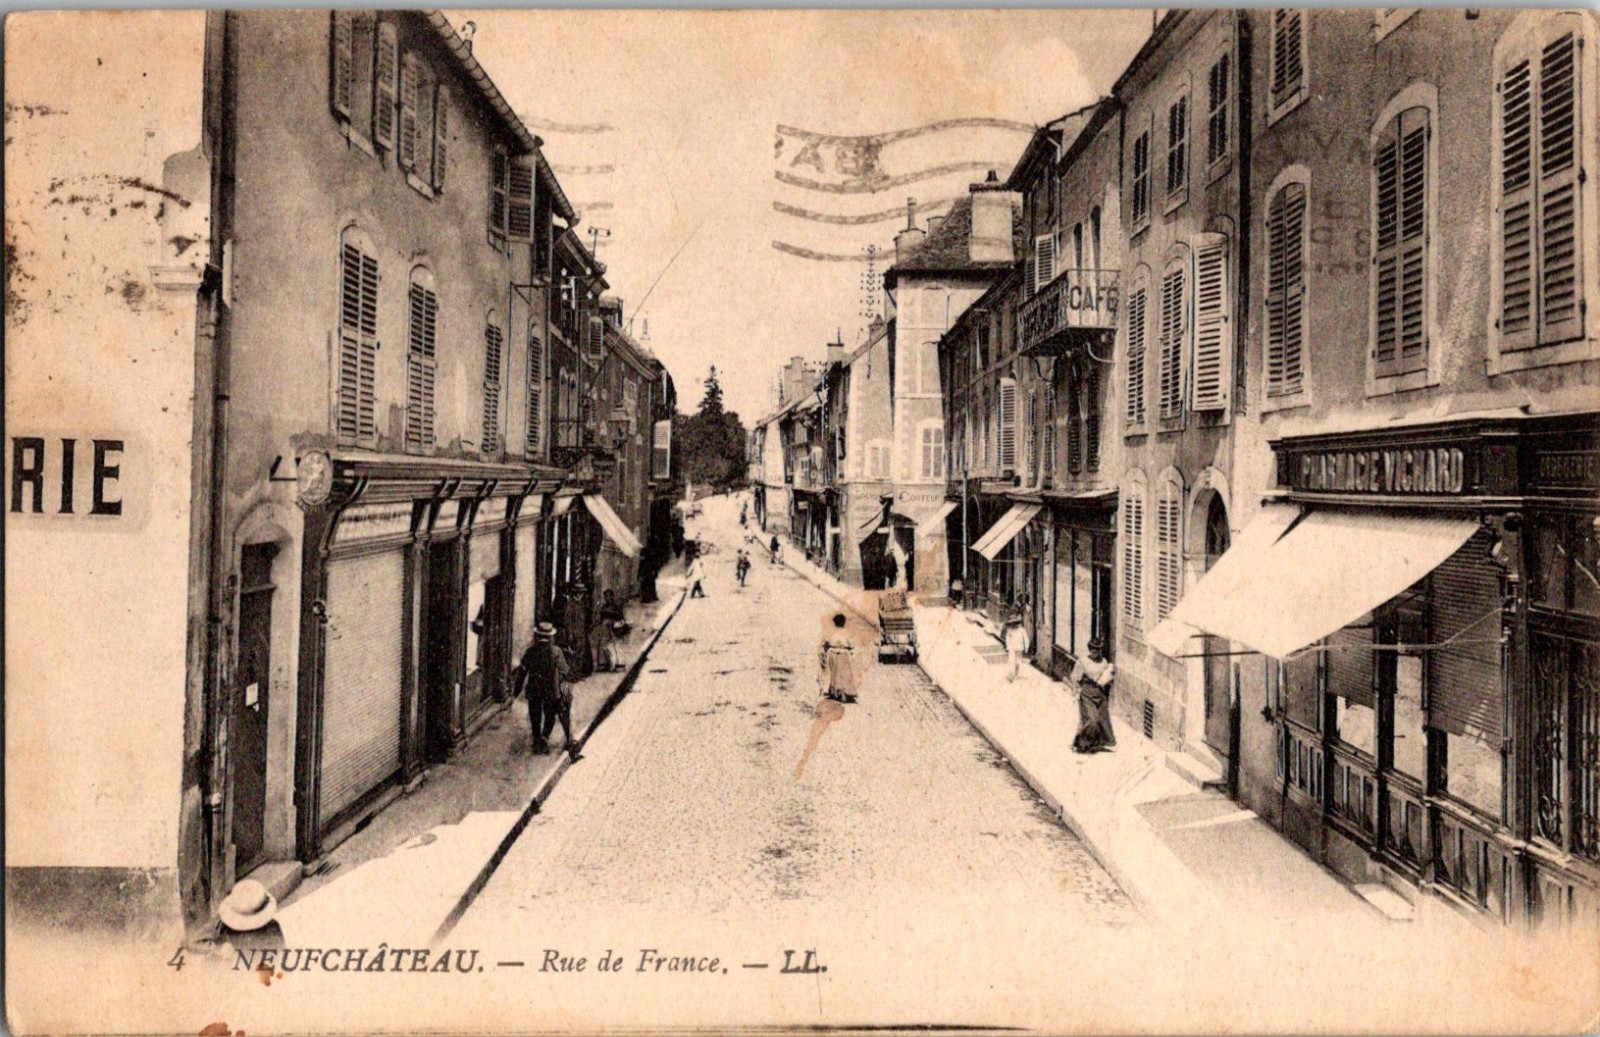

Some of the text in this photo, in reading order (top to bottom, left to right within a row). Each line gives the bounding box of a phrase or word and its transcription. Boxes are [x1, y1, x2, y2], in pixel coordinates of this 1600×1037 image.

[10, 437, 124, 516] RIE
[1301, 447, 1464, 494] PHARMACIE VICHARD
